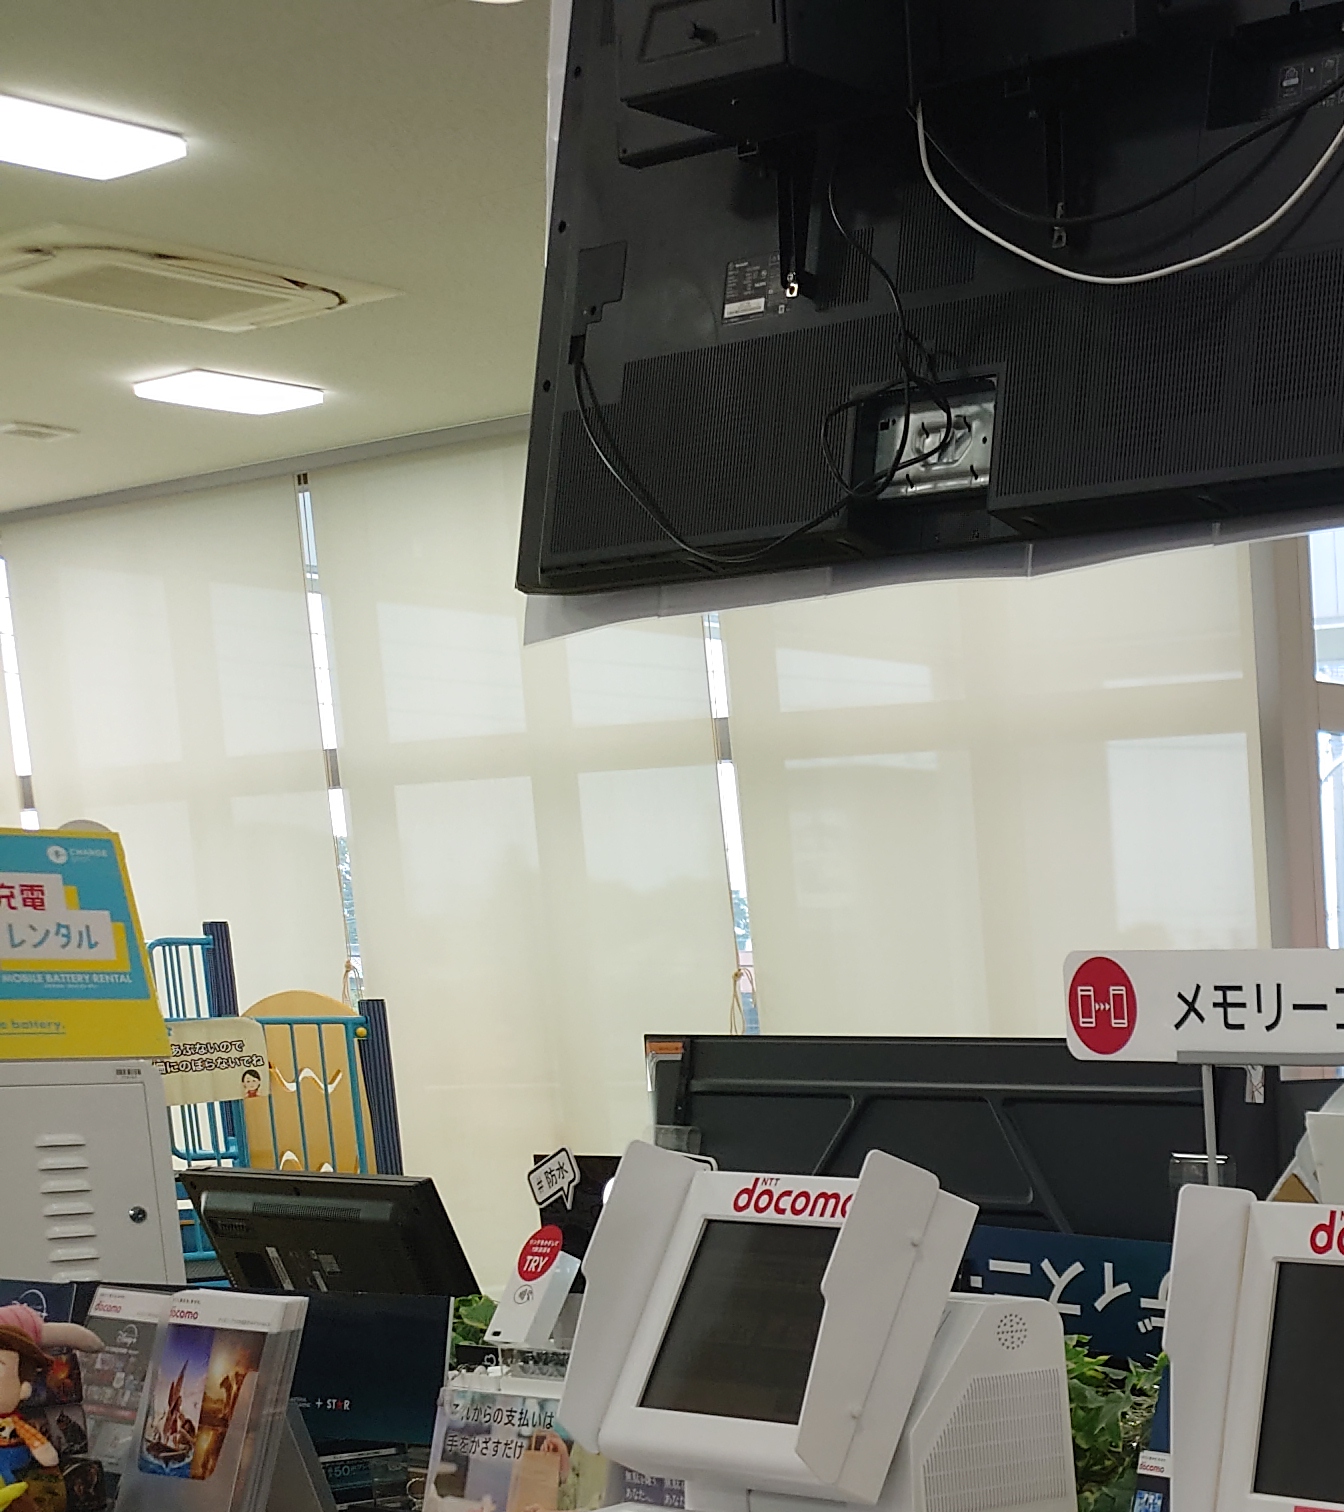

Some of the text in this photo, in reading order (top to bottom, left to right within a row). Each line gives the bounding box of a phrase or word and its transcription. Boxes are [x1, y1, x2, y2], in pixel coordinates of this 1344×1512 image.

[8, 922, 98, 950] レンタル
[46, 974, 91, 984] BATTERY
[93, 974, 132, 984] RENTAL
[543, 1160, 569, 1189] 防水
[761, 1177, 780, 1186] NTT
[523, 1255, 550, 1273] TRY
[446, 1434, 525, 1460] 手をかざすだけ
